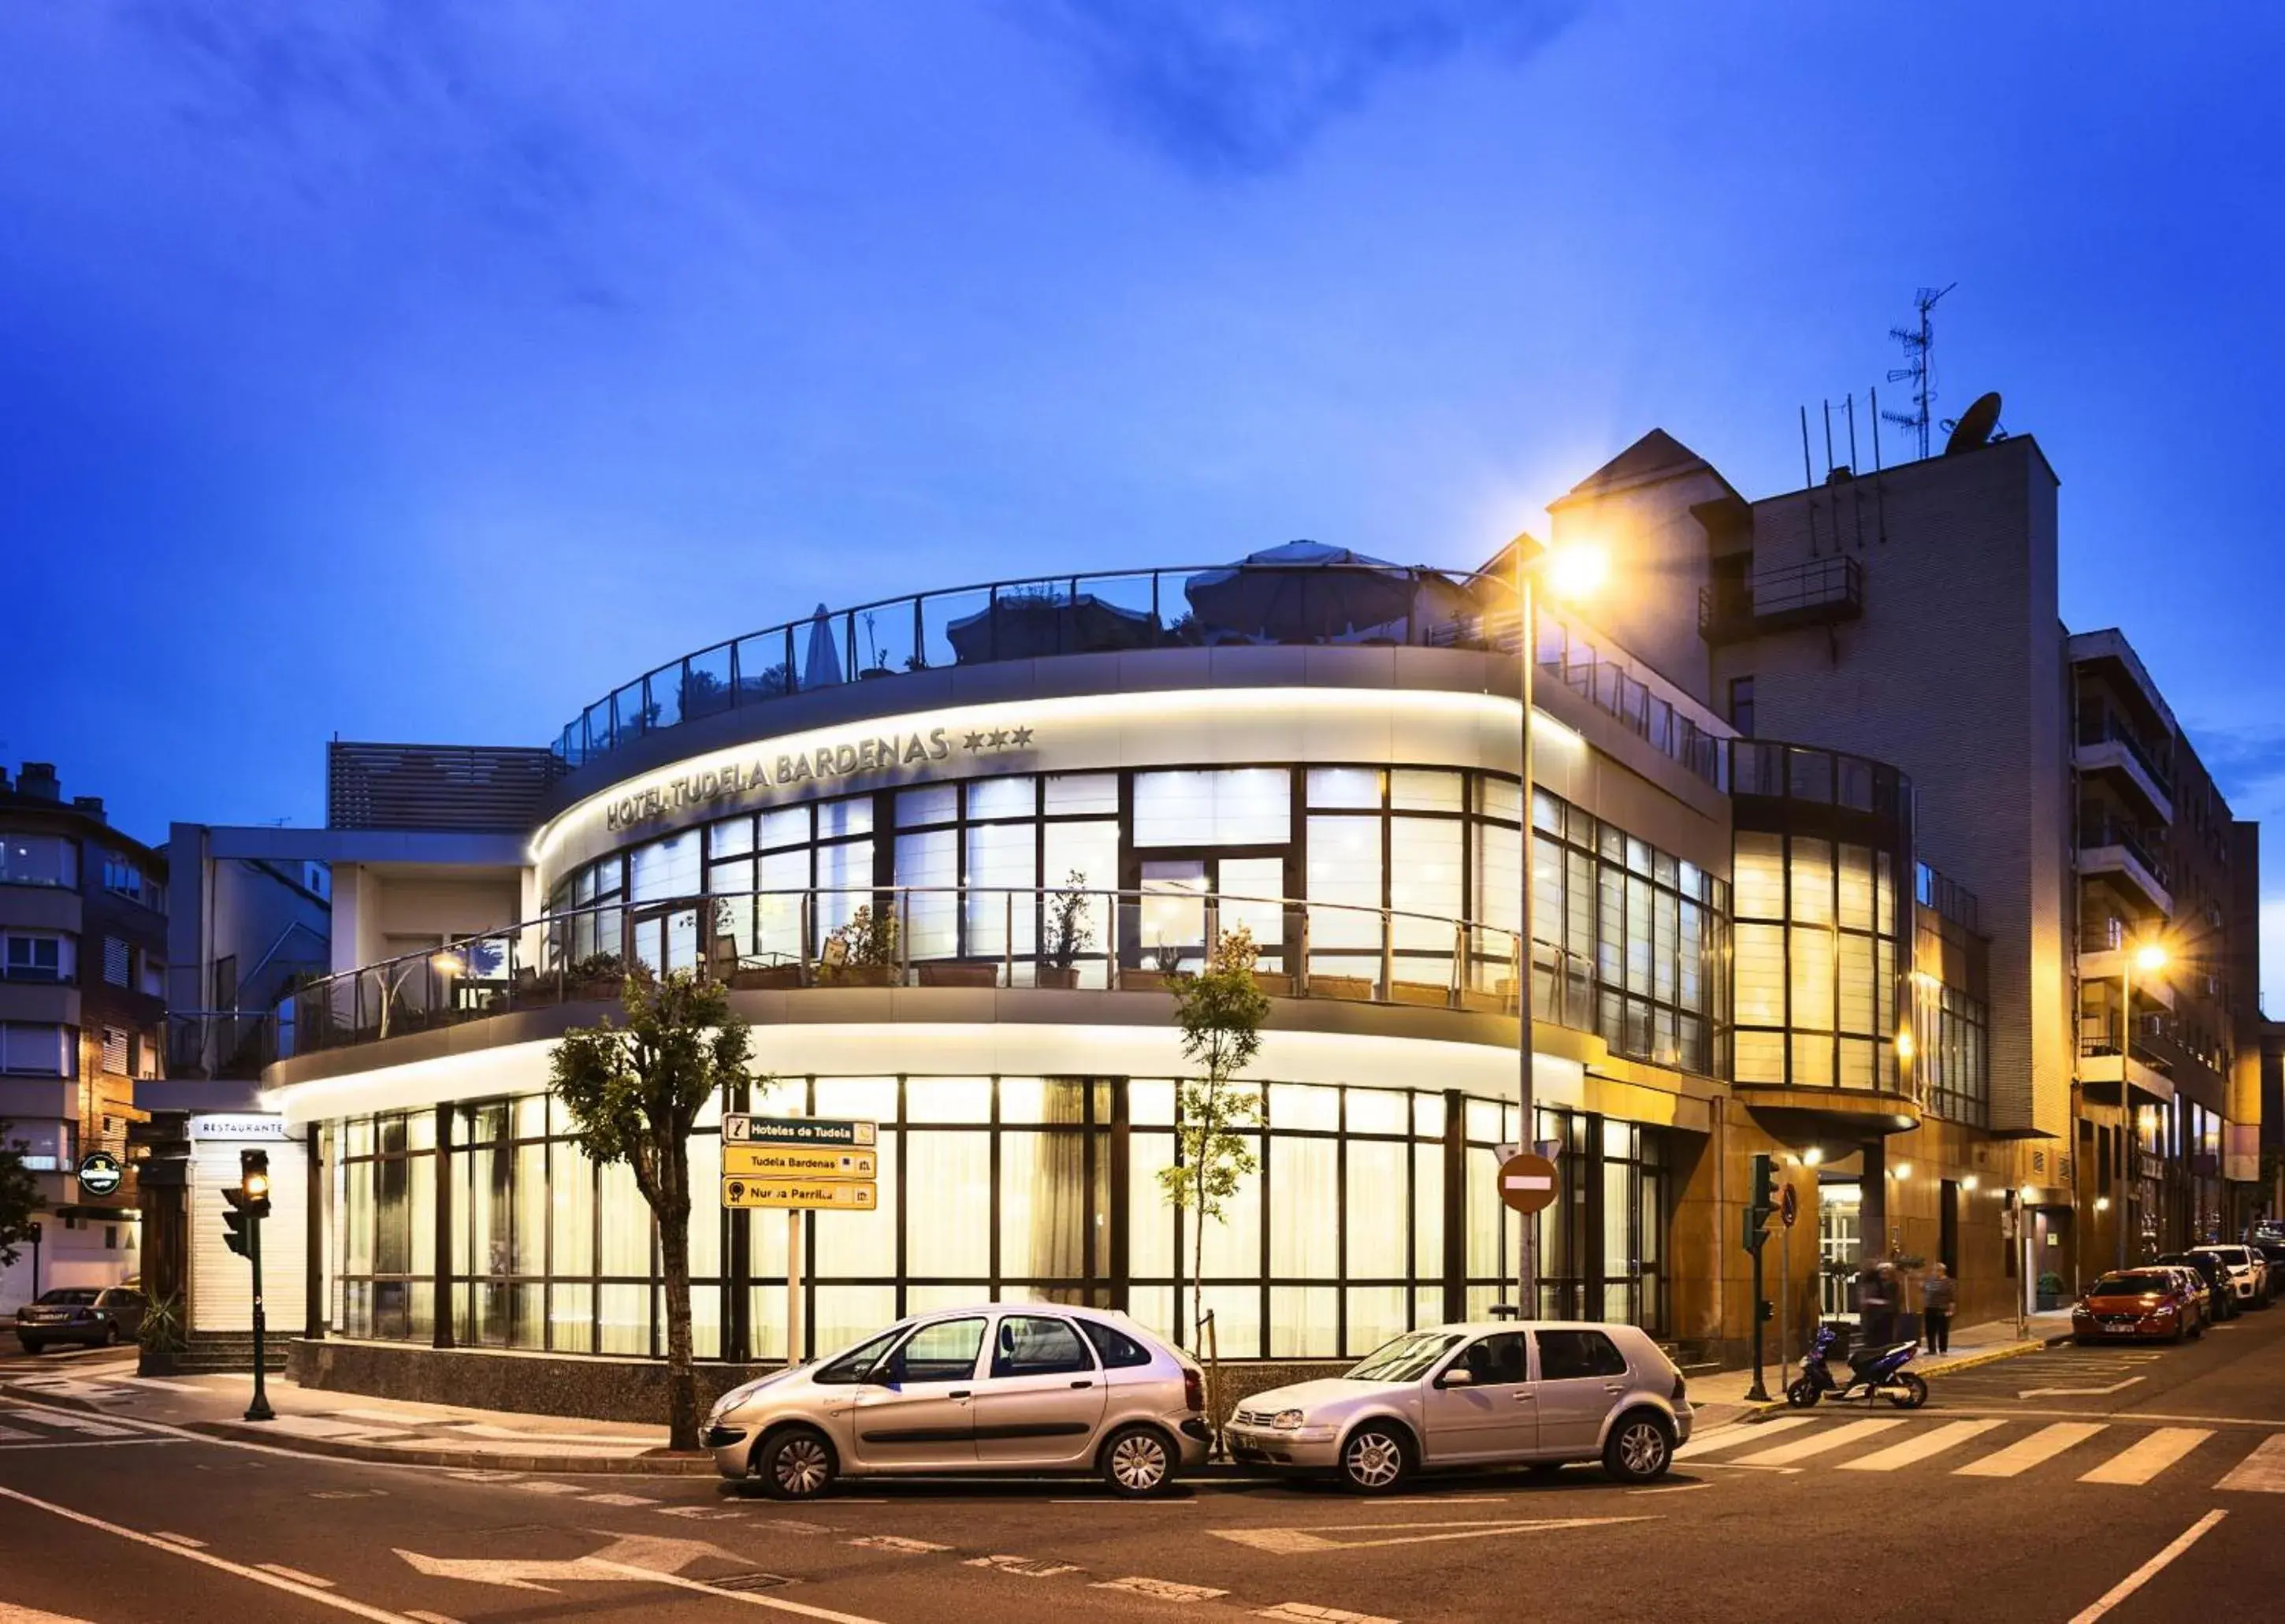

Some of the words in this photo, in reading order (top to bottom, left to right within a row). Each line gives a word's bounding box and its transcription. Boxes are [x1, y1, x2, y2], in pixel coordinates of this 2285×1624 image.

[607, 786, 670, 831] HOTEL
[671, 760, 769, 807] TUDELA
[776, 727, 949, 780] BARDENAS
[203, 1124, 283, 1132] RESTAURANTE
[752, 1124, 795, 1136] Hoteles
[797, 1126, 812, 1137] de
[814, 1128, 851, 1139] Tudela
[751, 1156, 786, 1167] Tudela
[789, 1158, 835, 1169] Bardenas
